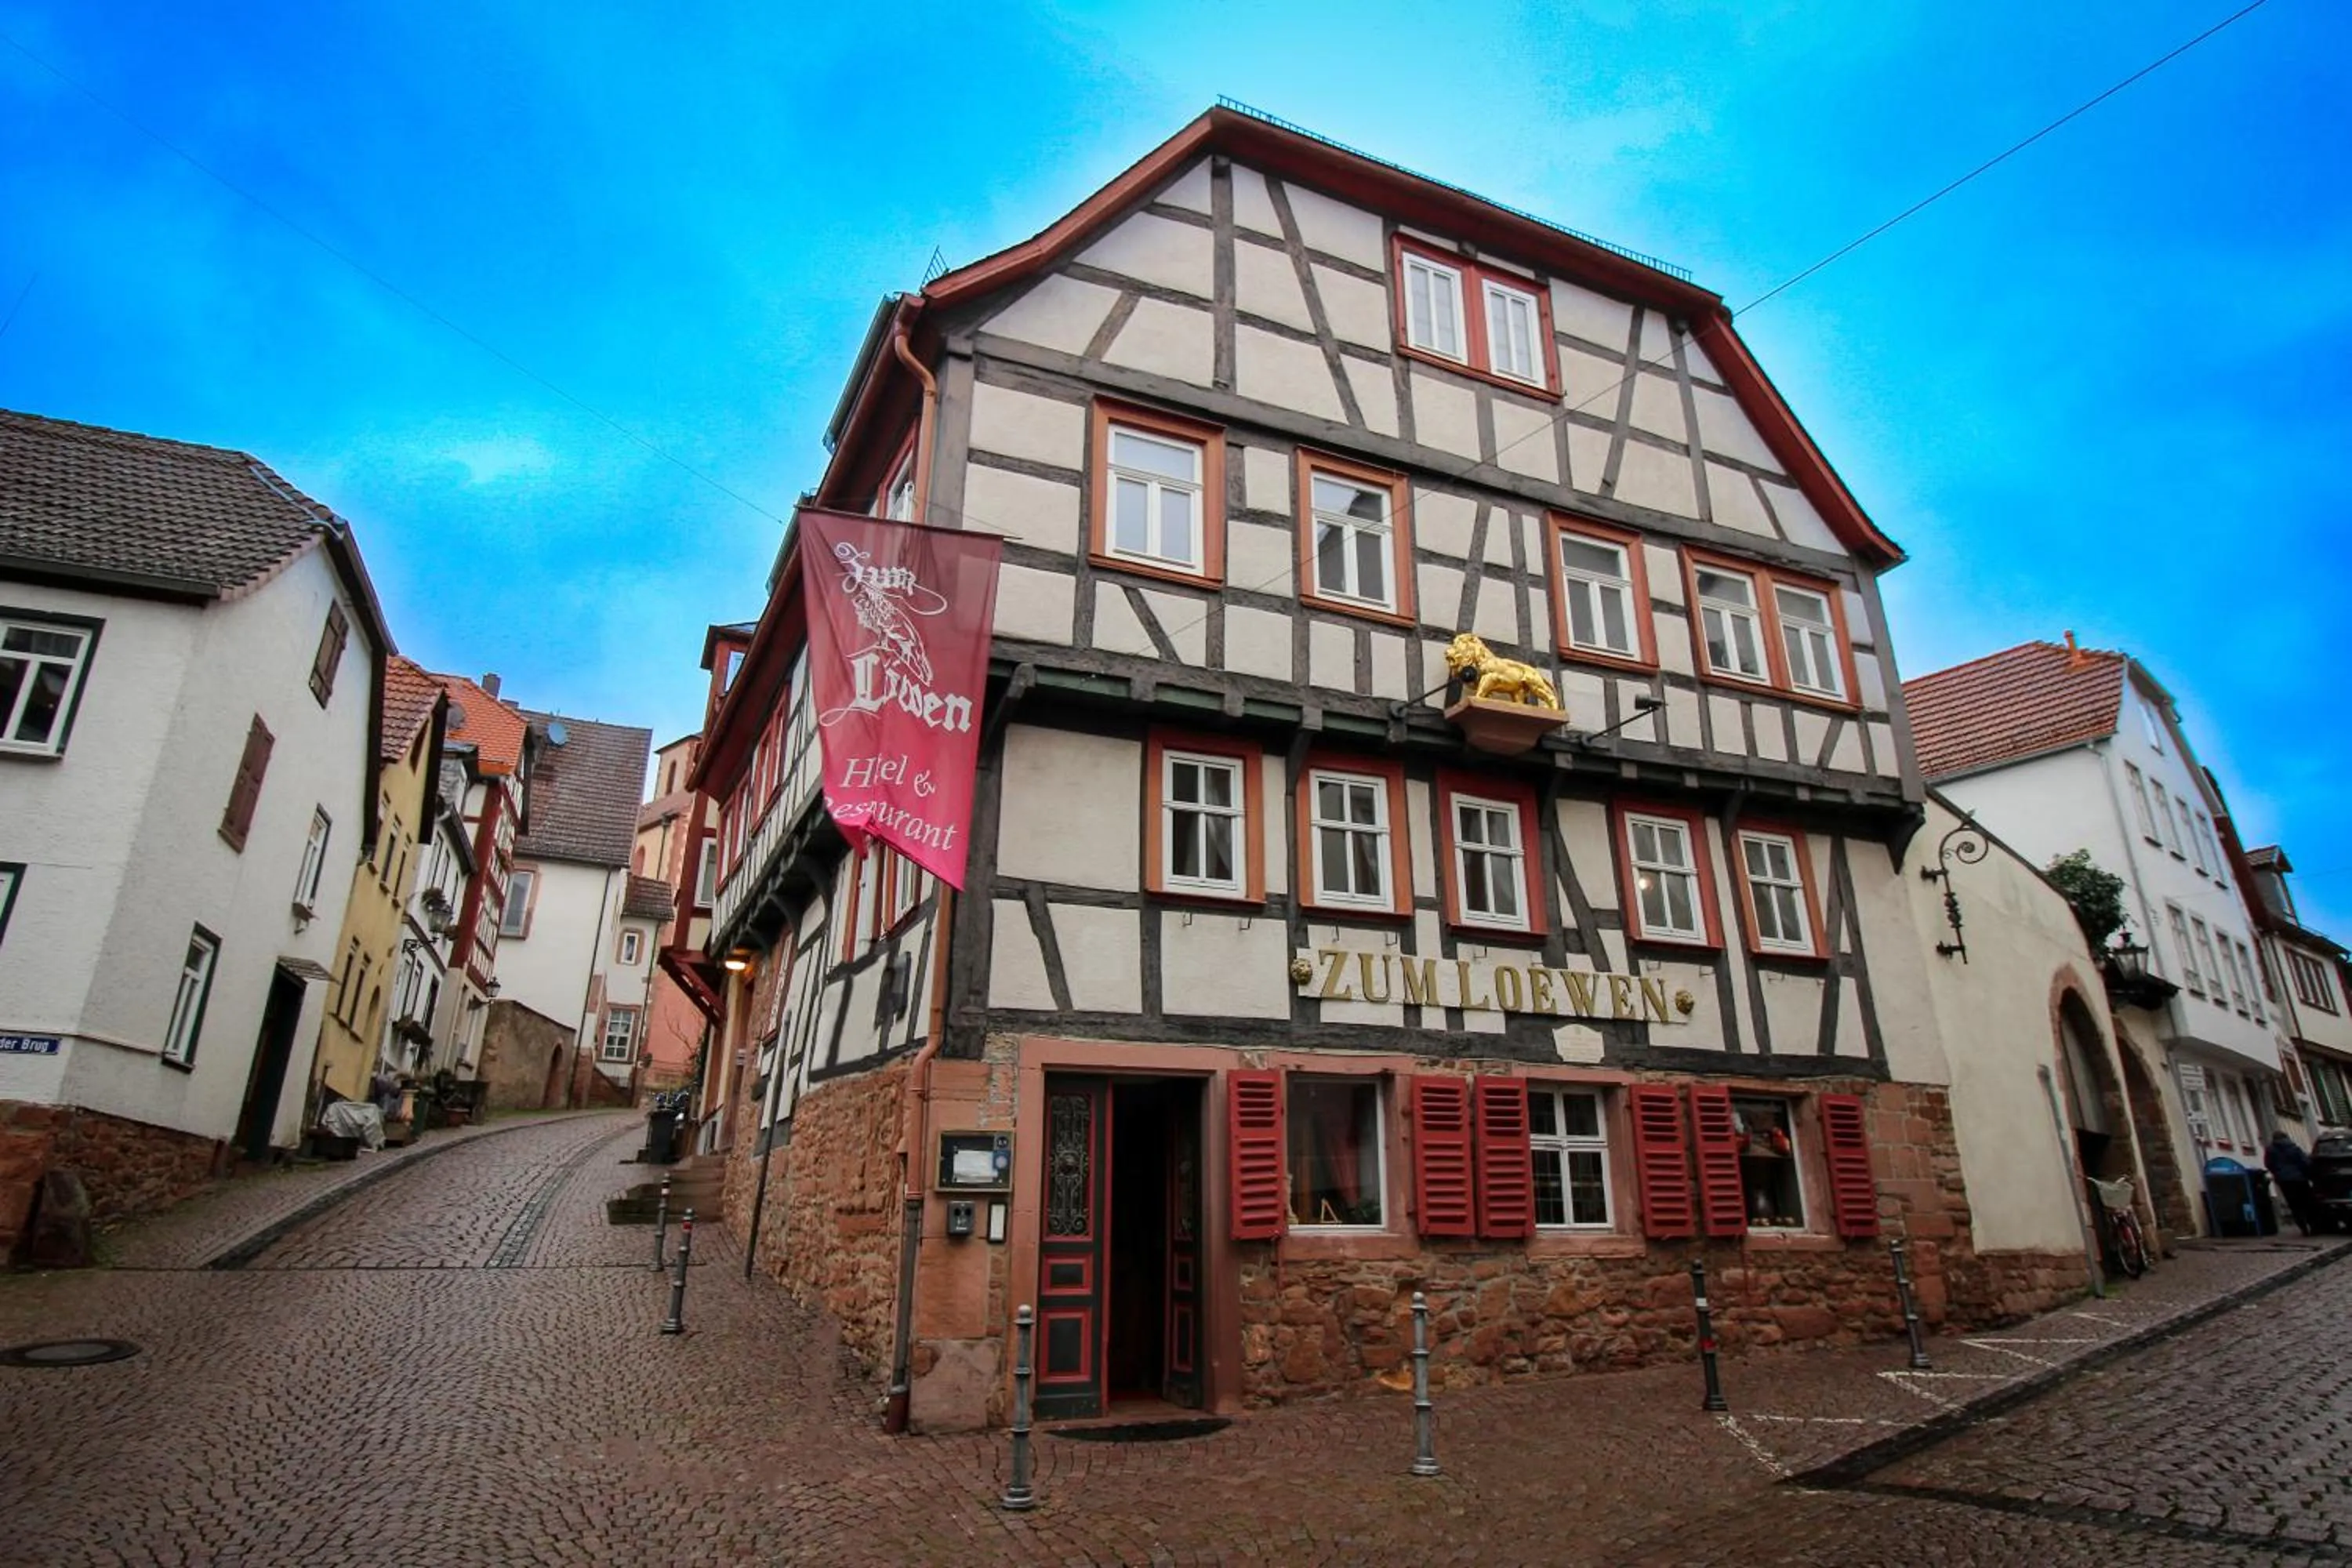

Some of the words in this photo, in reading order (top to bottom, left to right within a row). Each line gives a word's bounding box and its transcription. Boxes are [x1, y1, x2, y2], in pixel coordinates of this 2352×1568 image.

[834, 542, 933, 605] Zum
[913, 770, 935, 797] &
[1318, 949, 1439, 1007] ZUM
[1457, 960, 1670, 1022] LOEWEN
[21, 1038, 49, 1053] Brug
